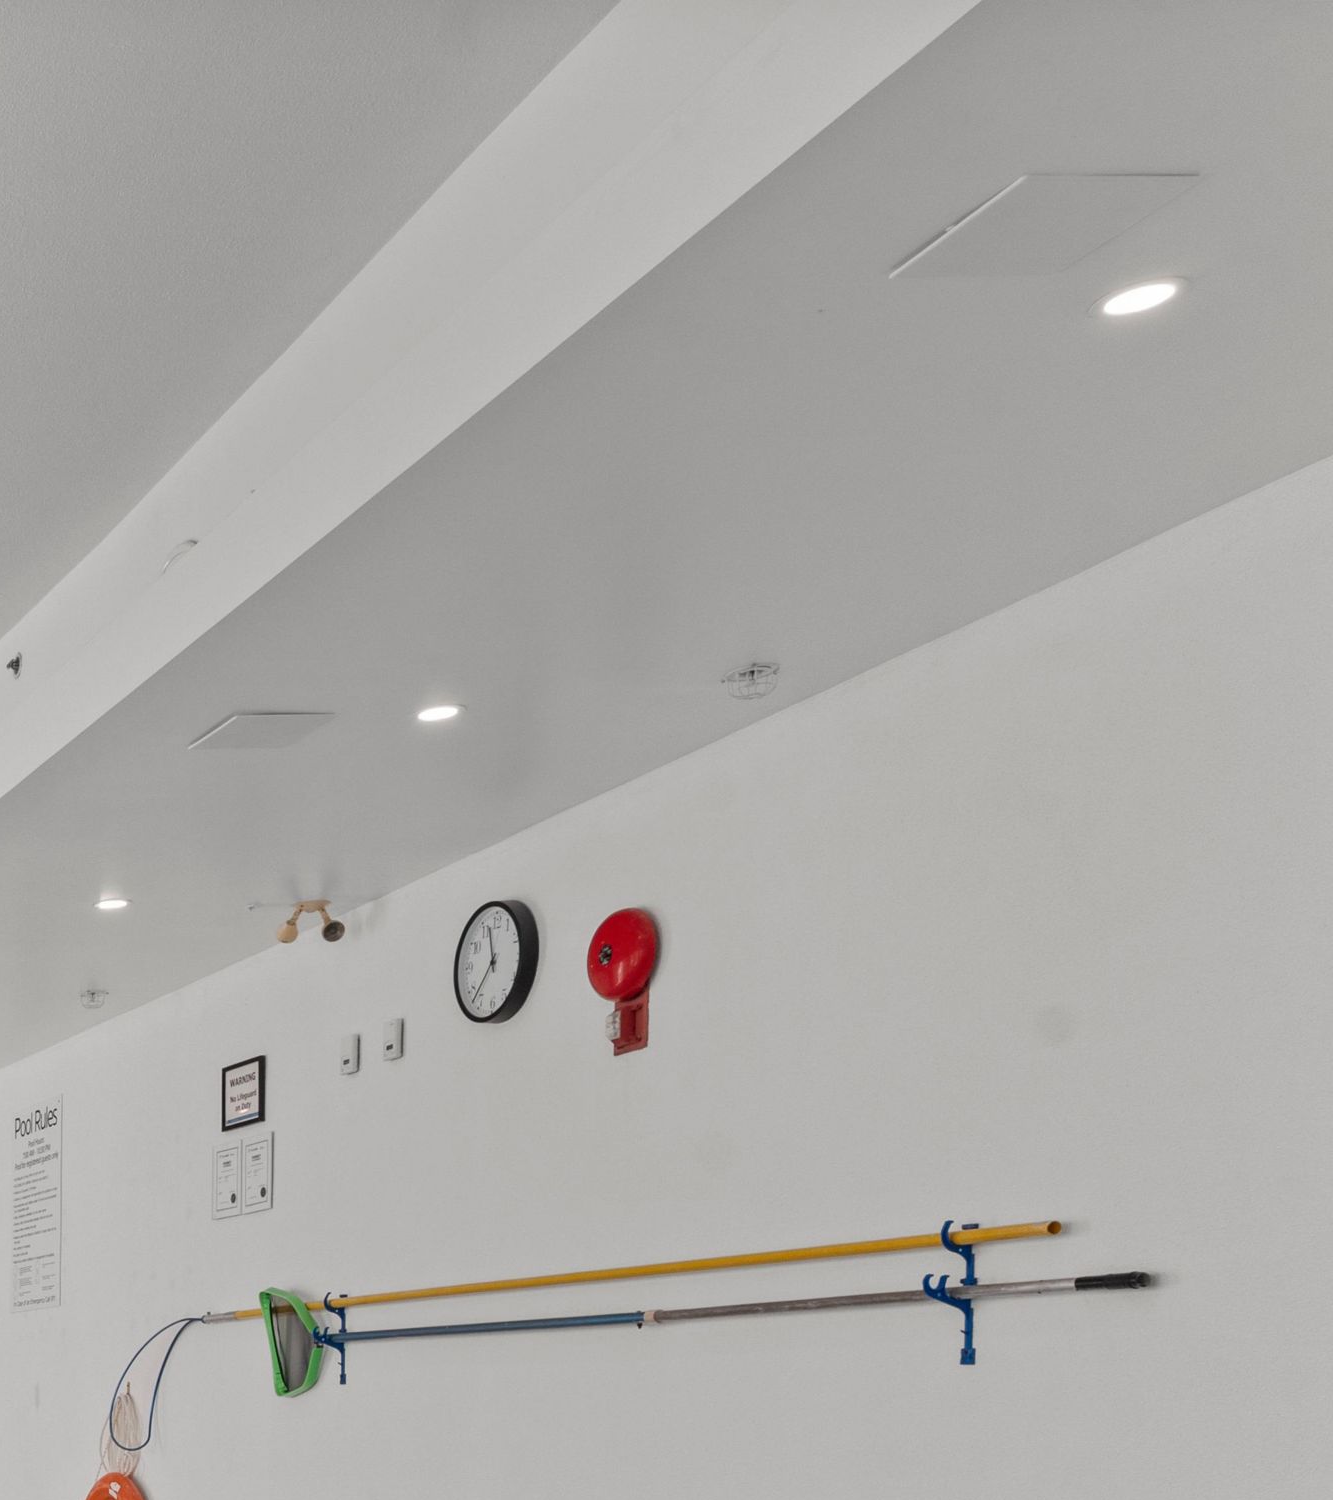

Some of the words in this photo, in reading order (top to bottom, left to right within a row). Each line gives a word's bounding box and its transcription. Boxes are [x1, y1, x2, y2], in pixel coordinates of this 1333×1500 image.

[493, 915, 502, 929] 12
[470, 942, 481, 954] 10
[229, 1072, 256, 1087] WARNING
[237, 1090, 257, 1101] Lifeguard
[14, 1111, 32, 1139] Pool
[35, 1106, 57, 1132] Rules
